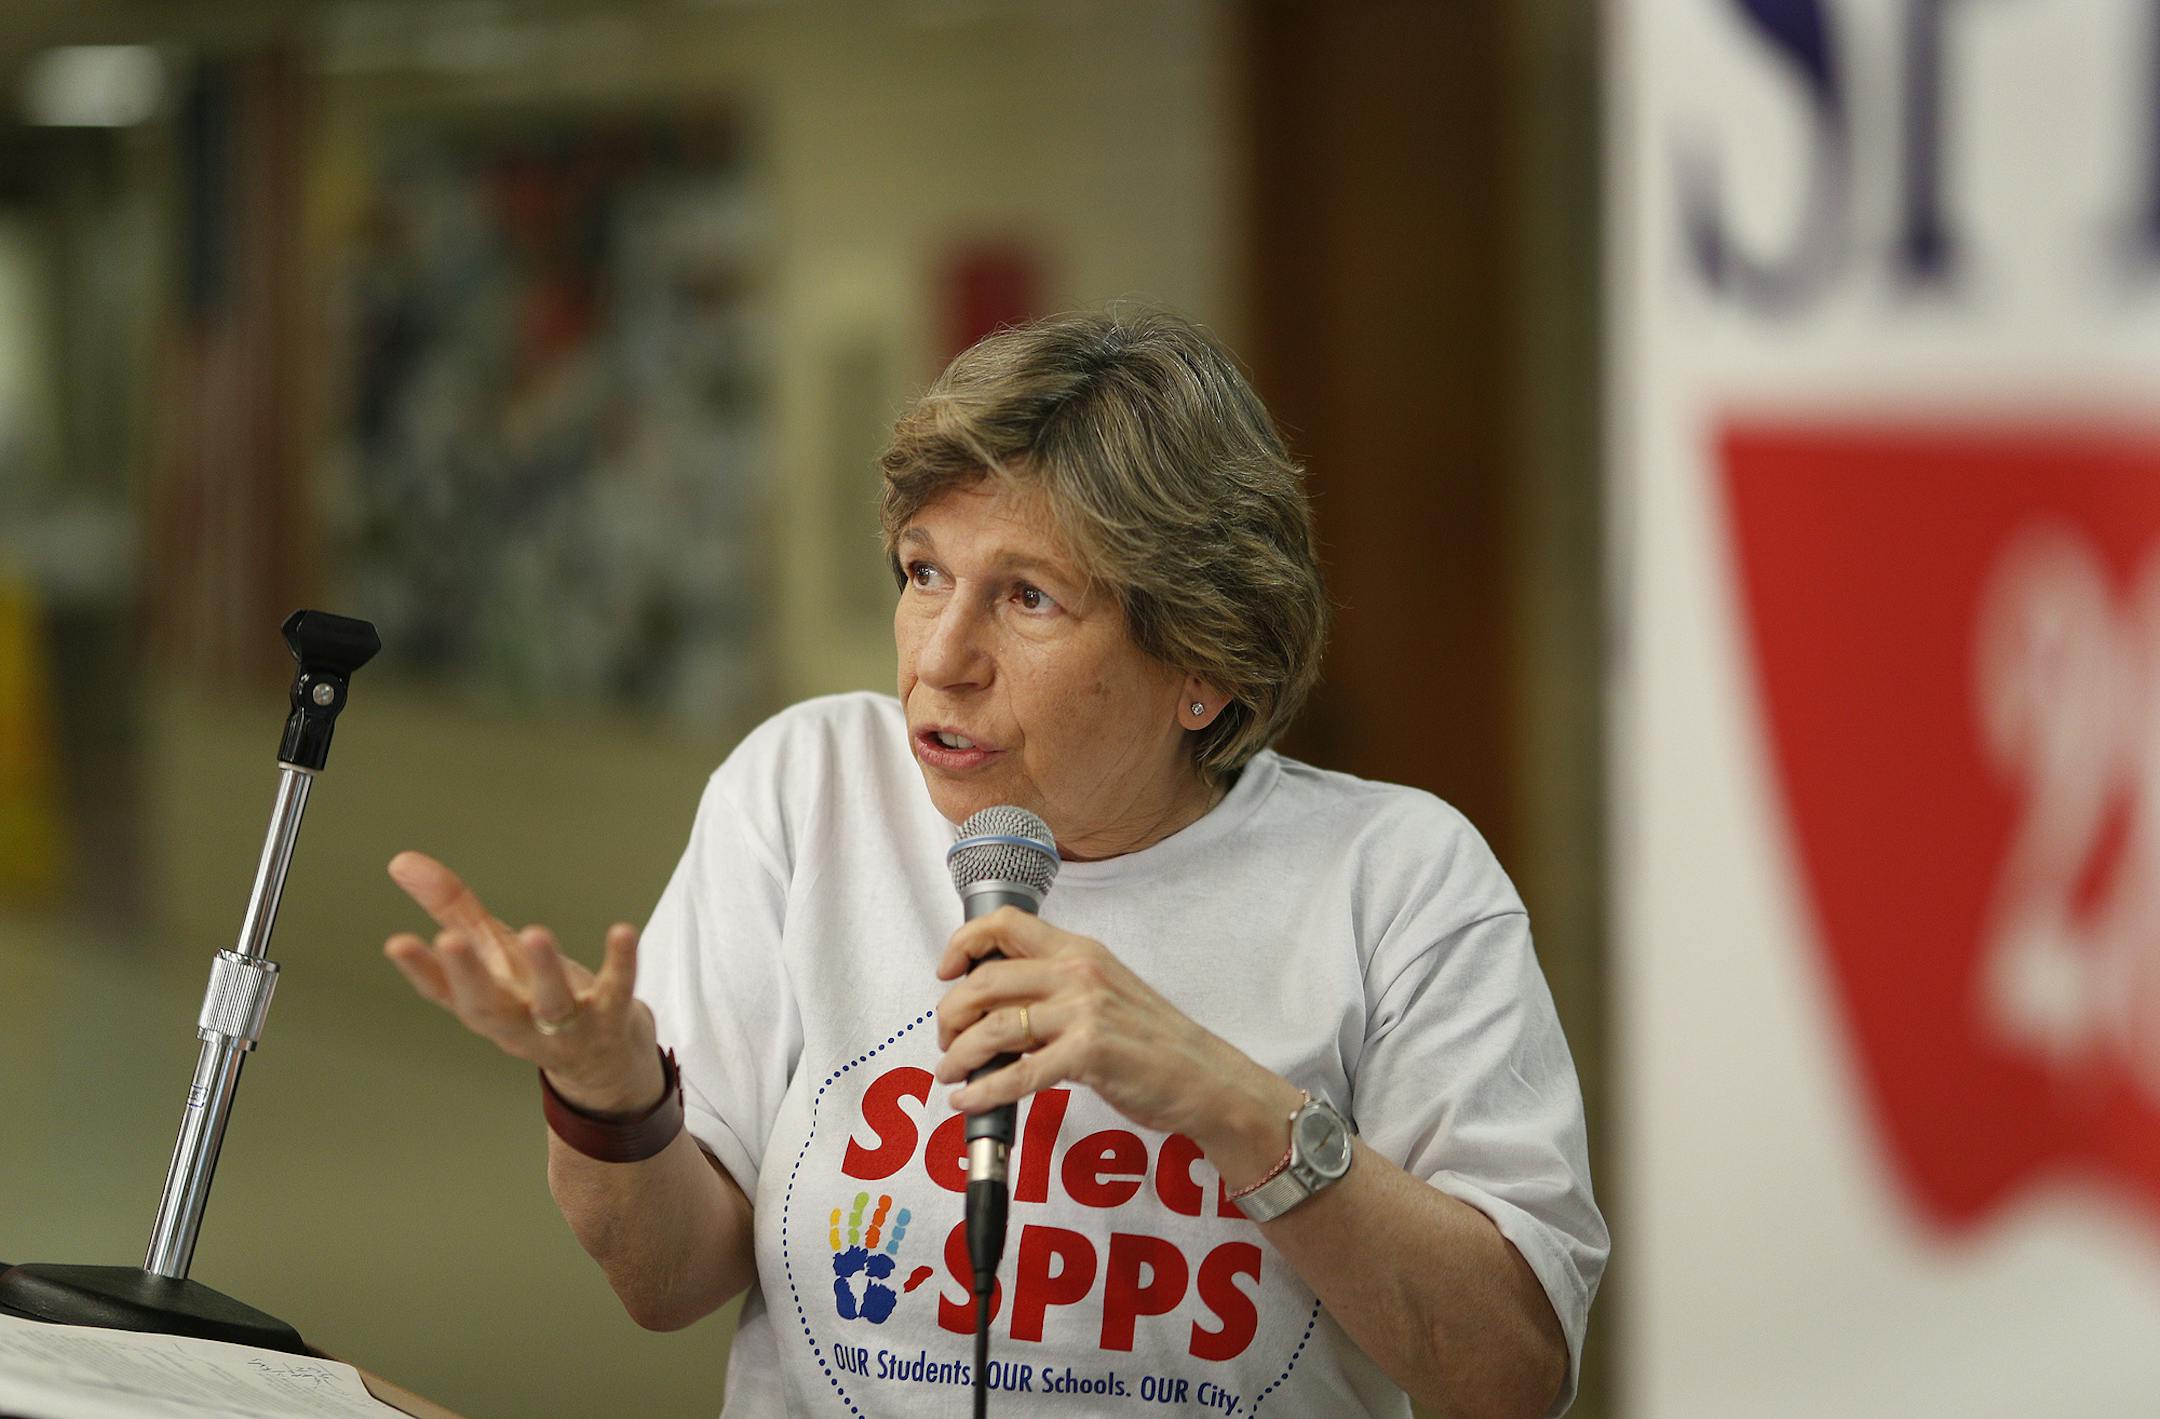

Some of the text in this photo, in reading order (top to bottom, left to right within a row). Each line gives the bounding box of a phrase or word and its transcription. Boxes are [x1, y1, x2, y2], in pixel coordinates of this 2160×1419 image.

[841, 1066, 1250, 1220] Selec
[937, 1219, 1262, 1363] SPPS
[833, 1342, 1243, 1416] OUR Students. OUR Schools. OUR City.
